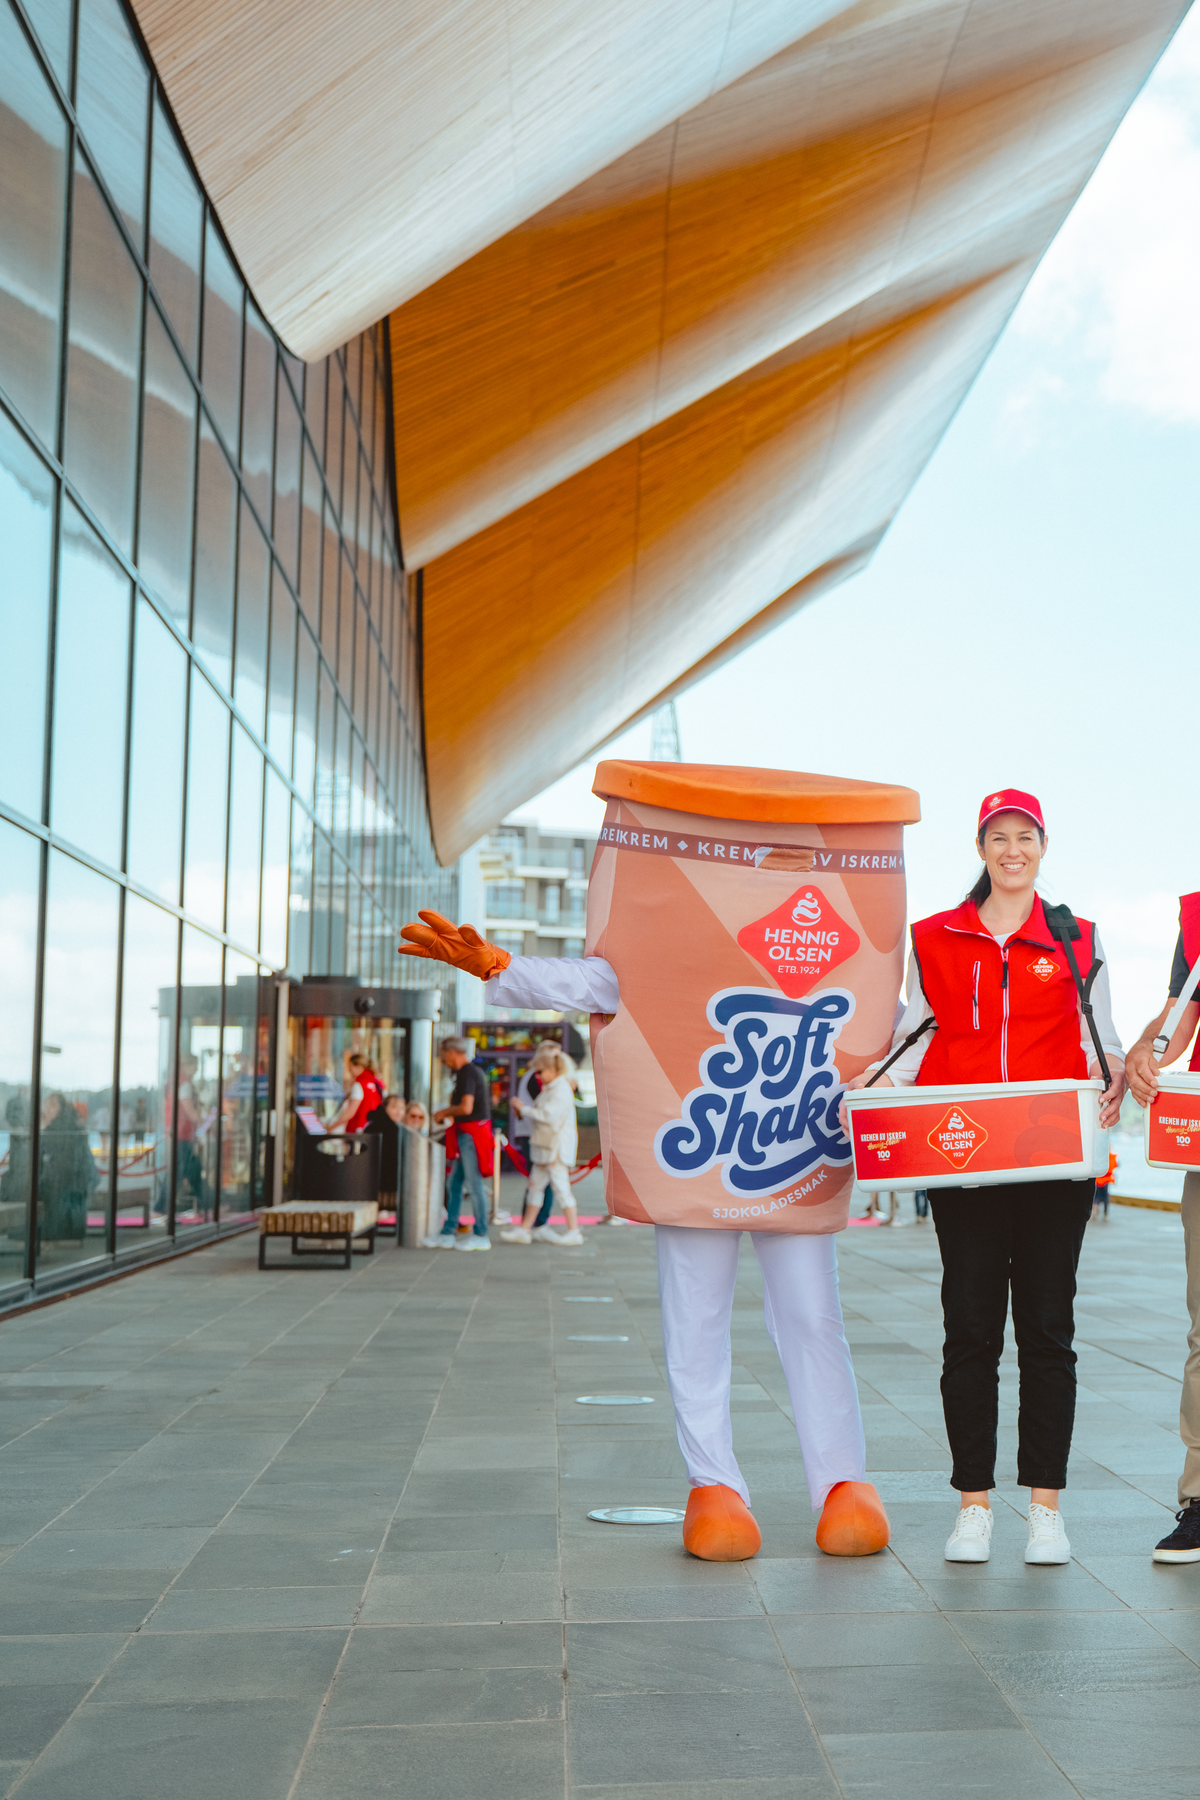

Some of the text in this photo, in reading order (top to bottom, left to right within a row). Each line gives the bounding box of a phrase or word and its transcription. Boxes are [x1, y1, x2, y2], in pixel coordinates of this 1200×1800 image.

[698, 842, 757, 861] KREM
[812, 853, 832, 867] V
[841, 854, 897, 869] ISKREM
[764, 928, 839, 946] HENNIG
[768, 945, 832, 962] OLSEN
[707, 993, 850, 1100] Soft
[938, 1130, 976, 1142] HENNIG
[1176, 1135, 1191, 1144] 100
[942, 1140, 973, 1151] OLSEN
[876, 1150, 891, 1159] 100
[712, 1169, 828, 1219] SJOKOLADESMAK
